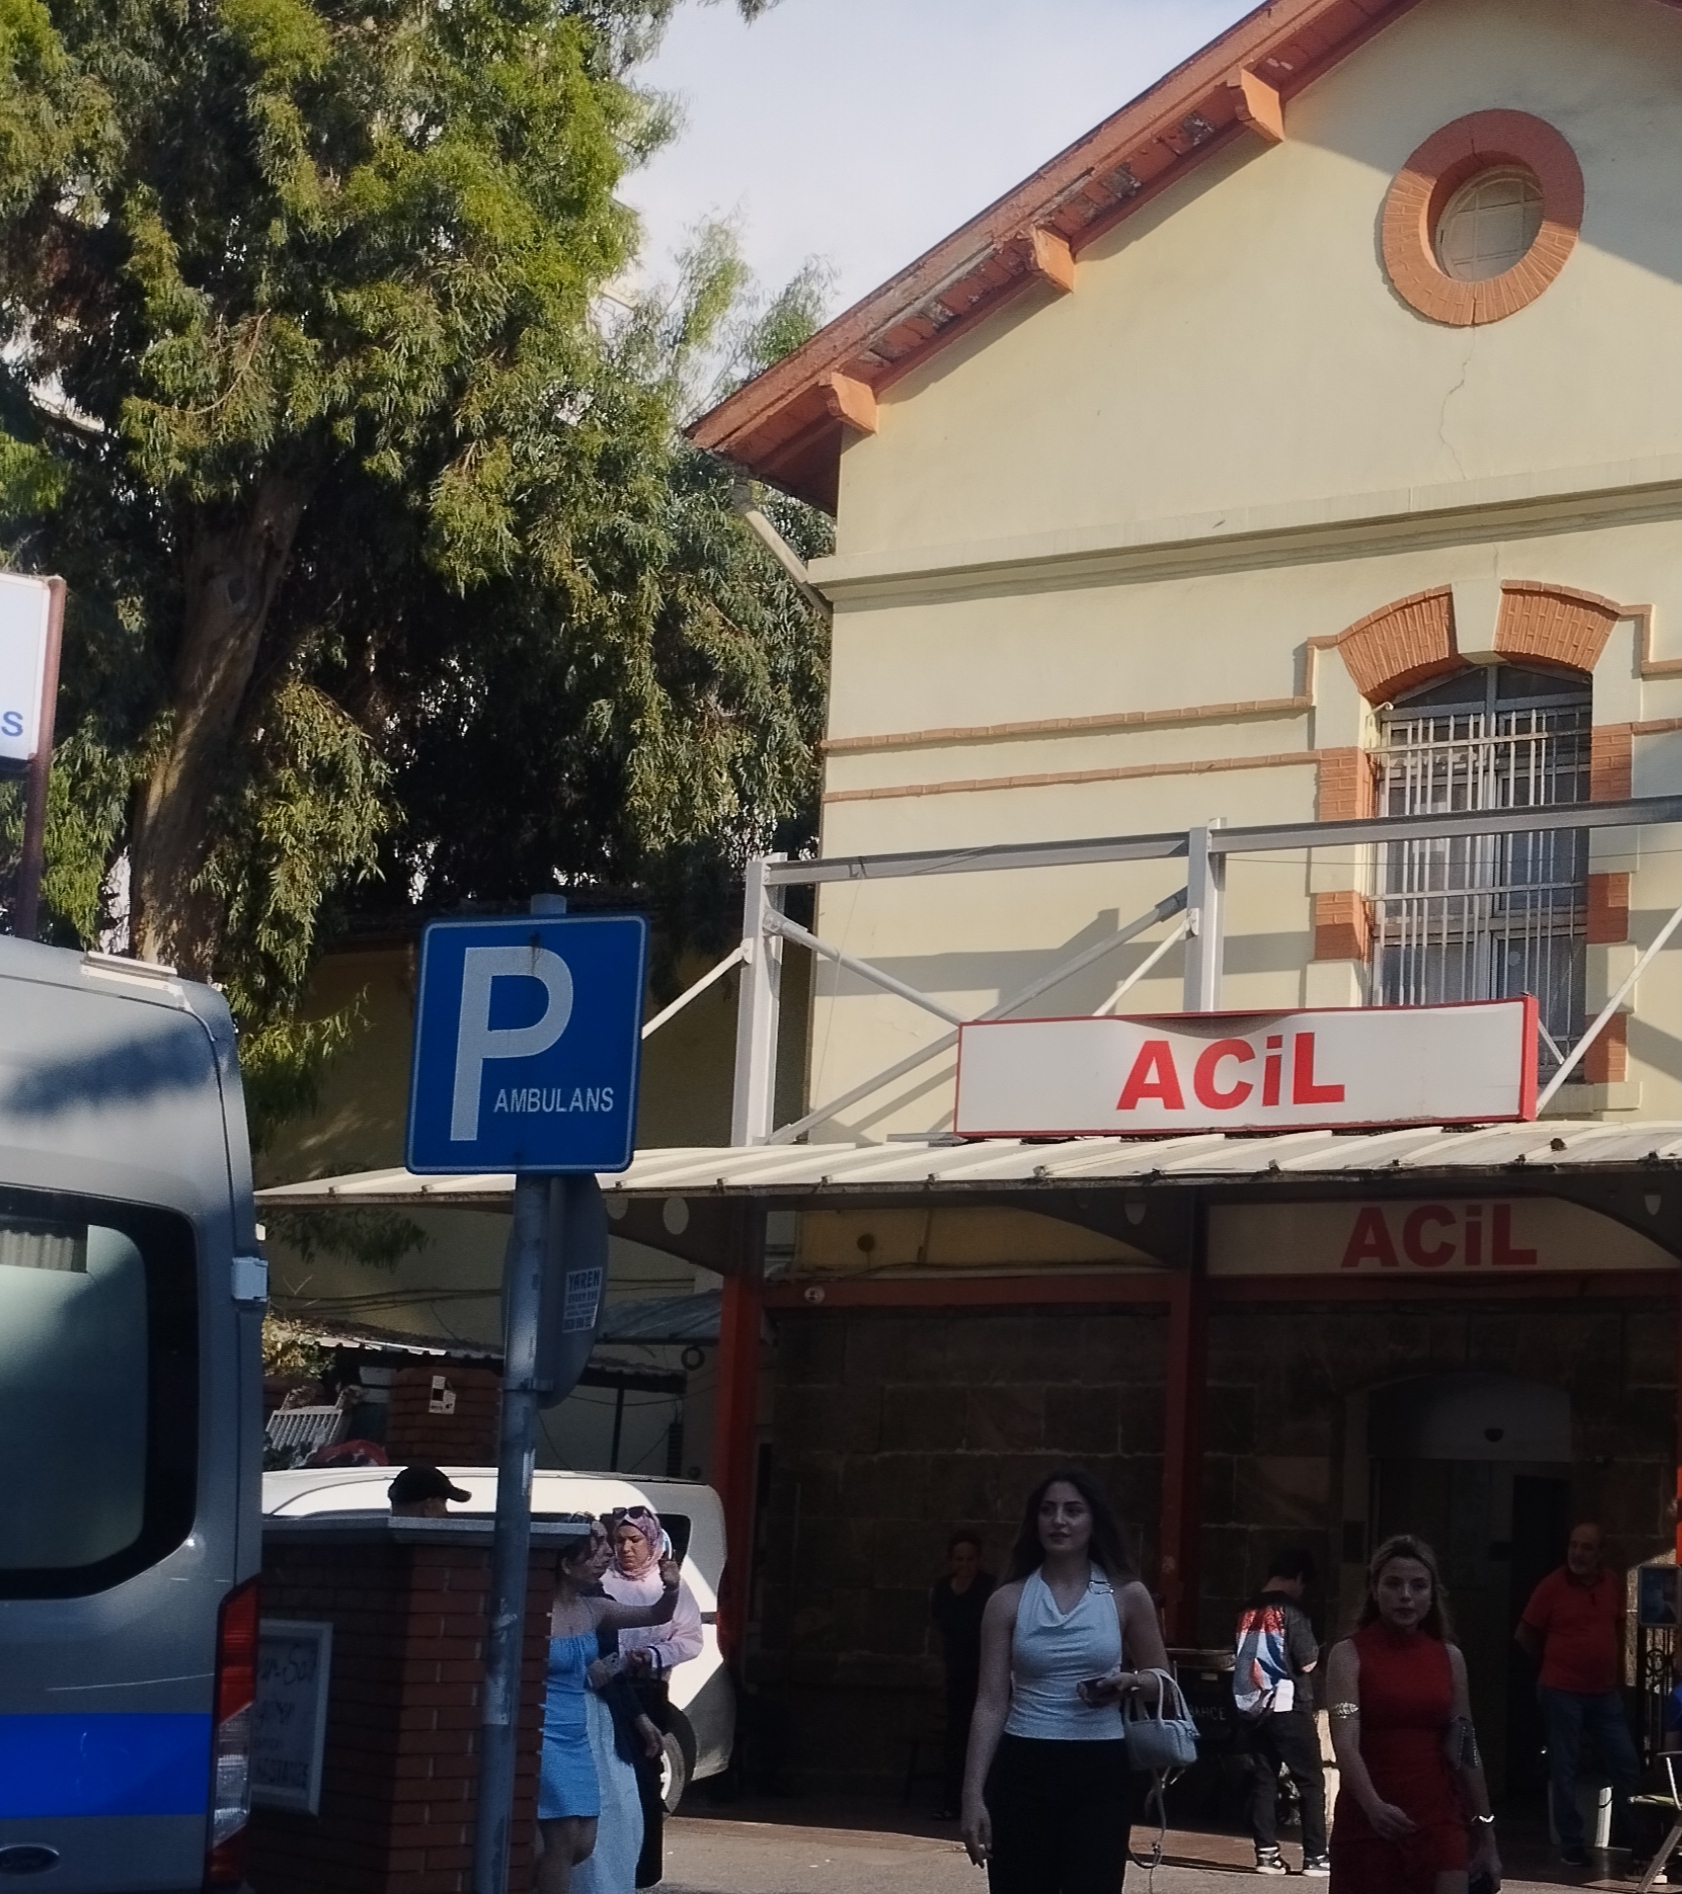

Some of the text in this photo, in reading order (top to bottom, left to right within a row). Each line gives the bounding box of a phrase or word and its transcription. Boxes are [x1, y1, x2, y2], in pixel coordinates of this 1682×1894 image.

[450, 946, 574, 1143] P
[494, 1087, 615, 1113] AMBULANS
[569, 1270, 600, 1292] YAREN
